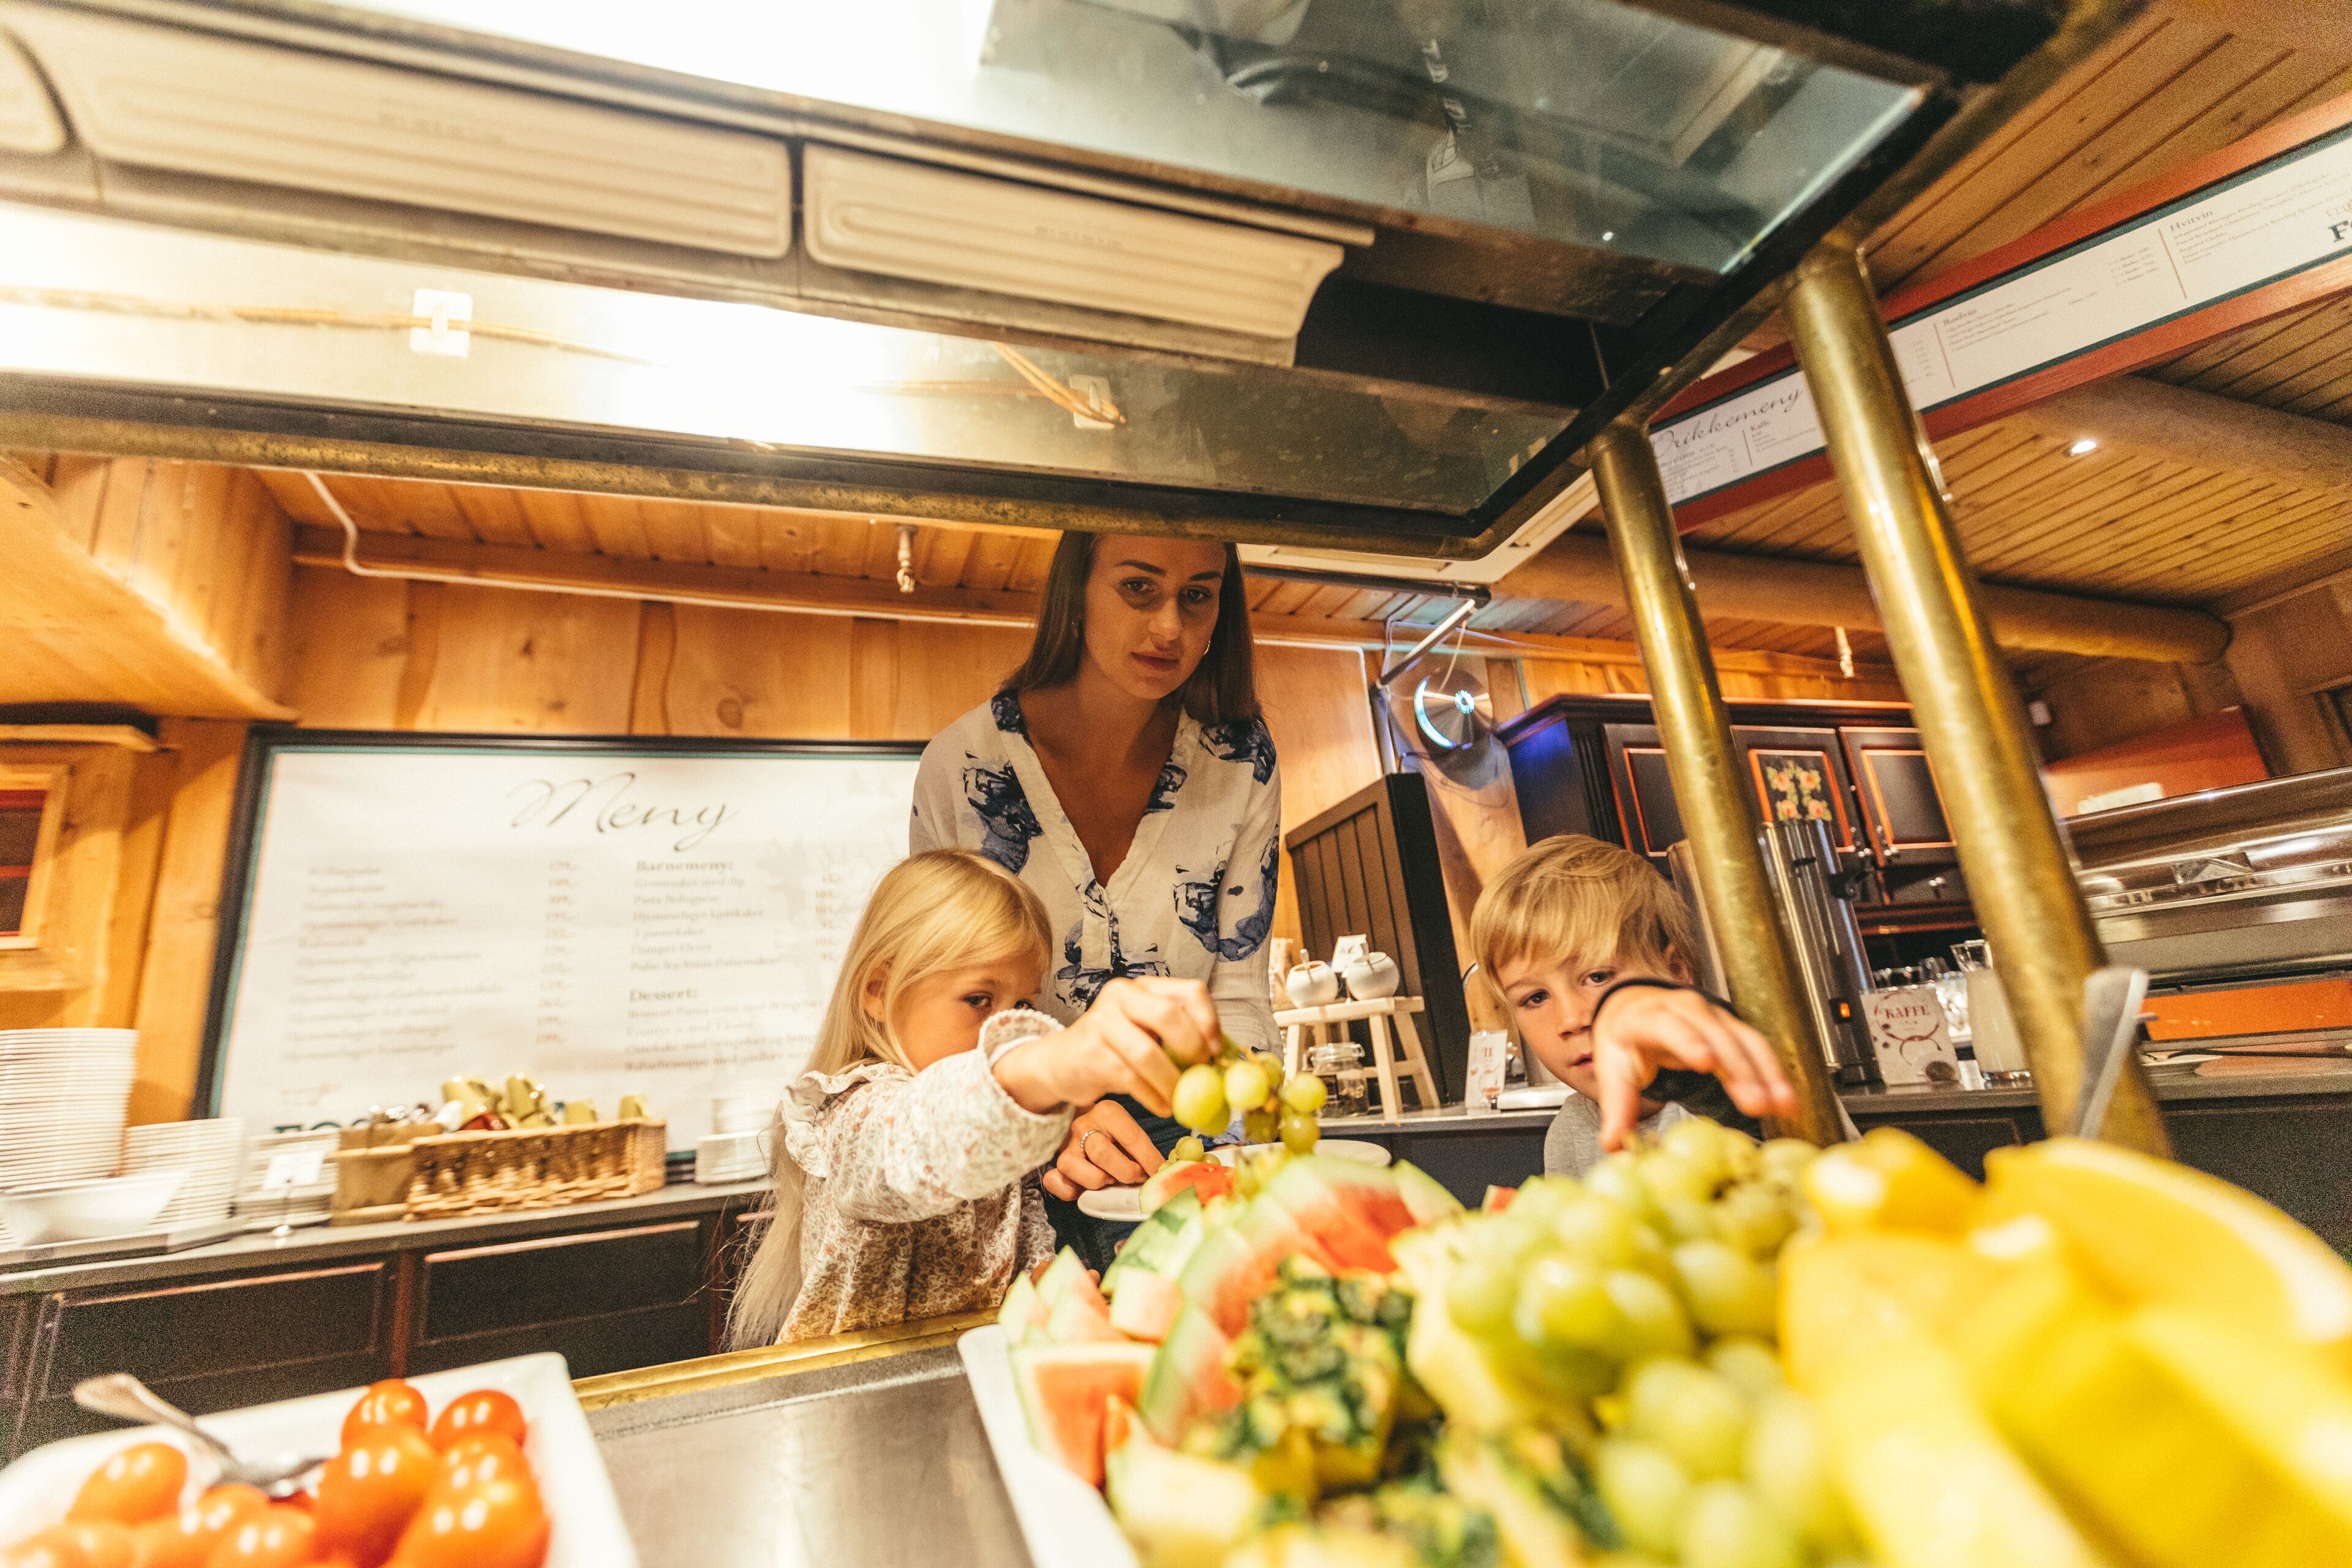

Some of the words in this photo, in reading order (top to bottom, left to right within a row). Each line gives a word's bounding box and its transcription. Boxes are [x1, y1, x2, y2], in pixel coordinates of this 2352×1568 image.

[2169, 209, 2214, 232] Hvitvin
[2328, 220, 2352, 243] F
[501, 772, 737, 852] Meny
[636, 860, 734, 874] Barnemeny:
[629, 987, 697, 1002] Dessert:
[1885, 1005, 1931, 1019] KAFFE
[1481, 1047, 1494, 1058] TE
